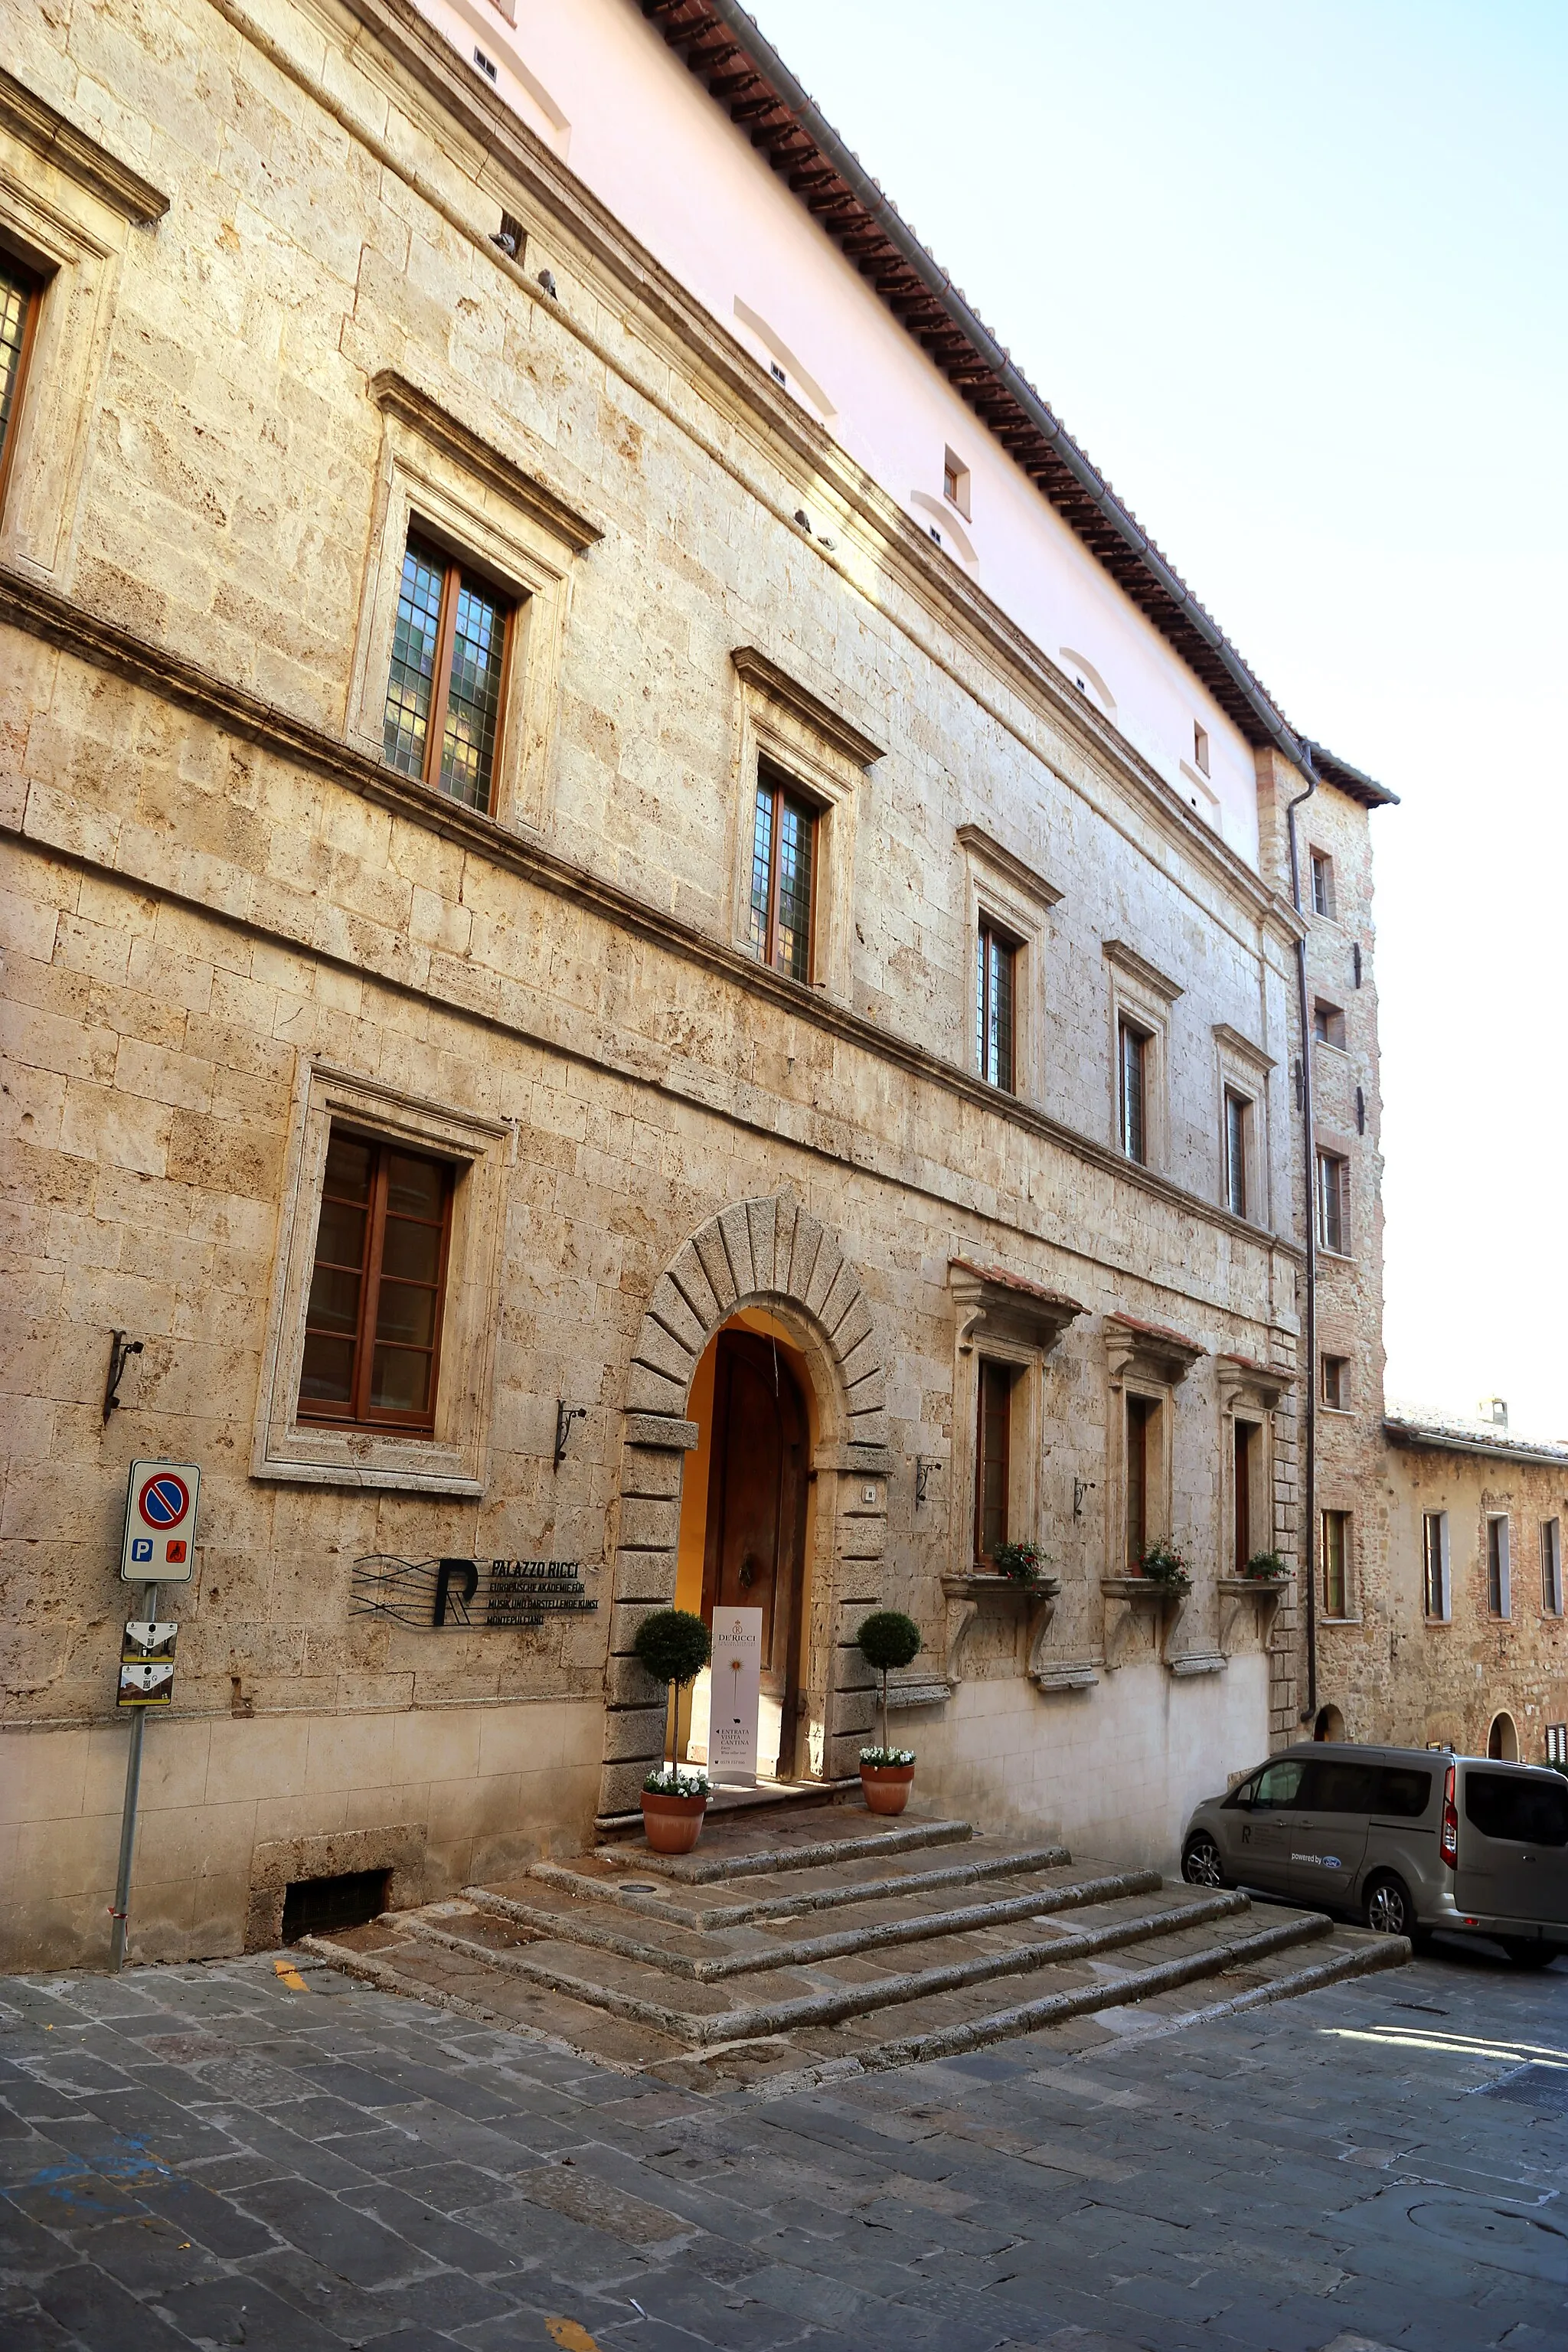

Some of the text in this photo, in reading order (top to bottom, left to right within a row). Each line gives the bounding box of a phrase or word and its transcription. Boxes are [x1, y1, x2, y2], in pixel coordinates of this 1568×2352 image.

[136, 1541, 150, 1559] P
[492, 1560, 578, 1578] PALAZZO RICCI
[489, 1581, 584, 1592] EUROPÄISCHE AKADEMIE FÜR
[488, 1599, 511, 1608] MUSIK
[511, 1599, 528, 1609] UND
[578, 1599, 599, 1609] KUNST
[486, 1615, 544, 1625] MONTEPULCIANO
[1291, 1853, 1315, 1863] powered
[1315, 1855, 1322, 1865] by
